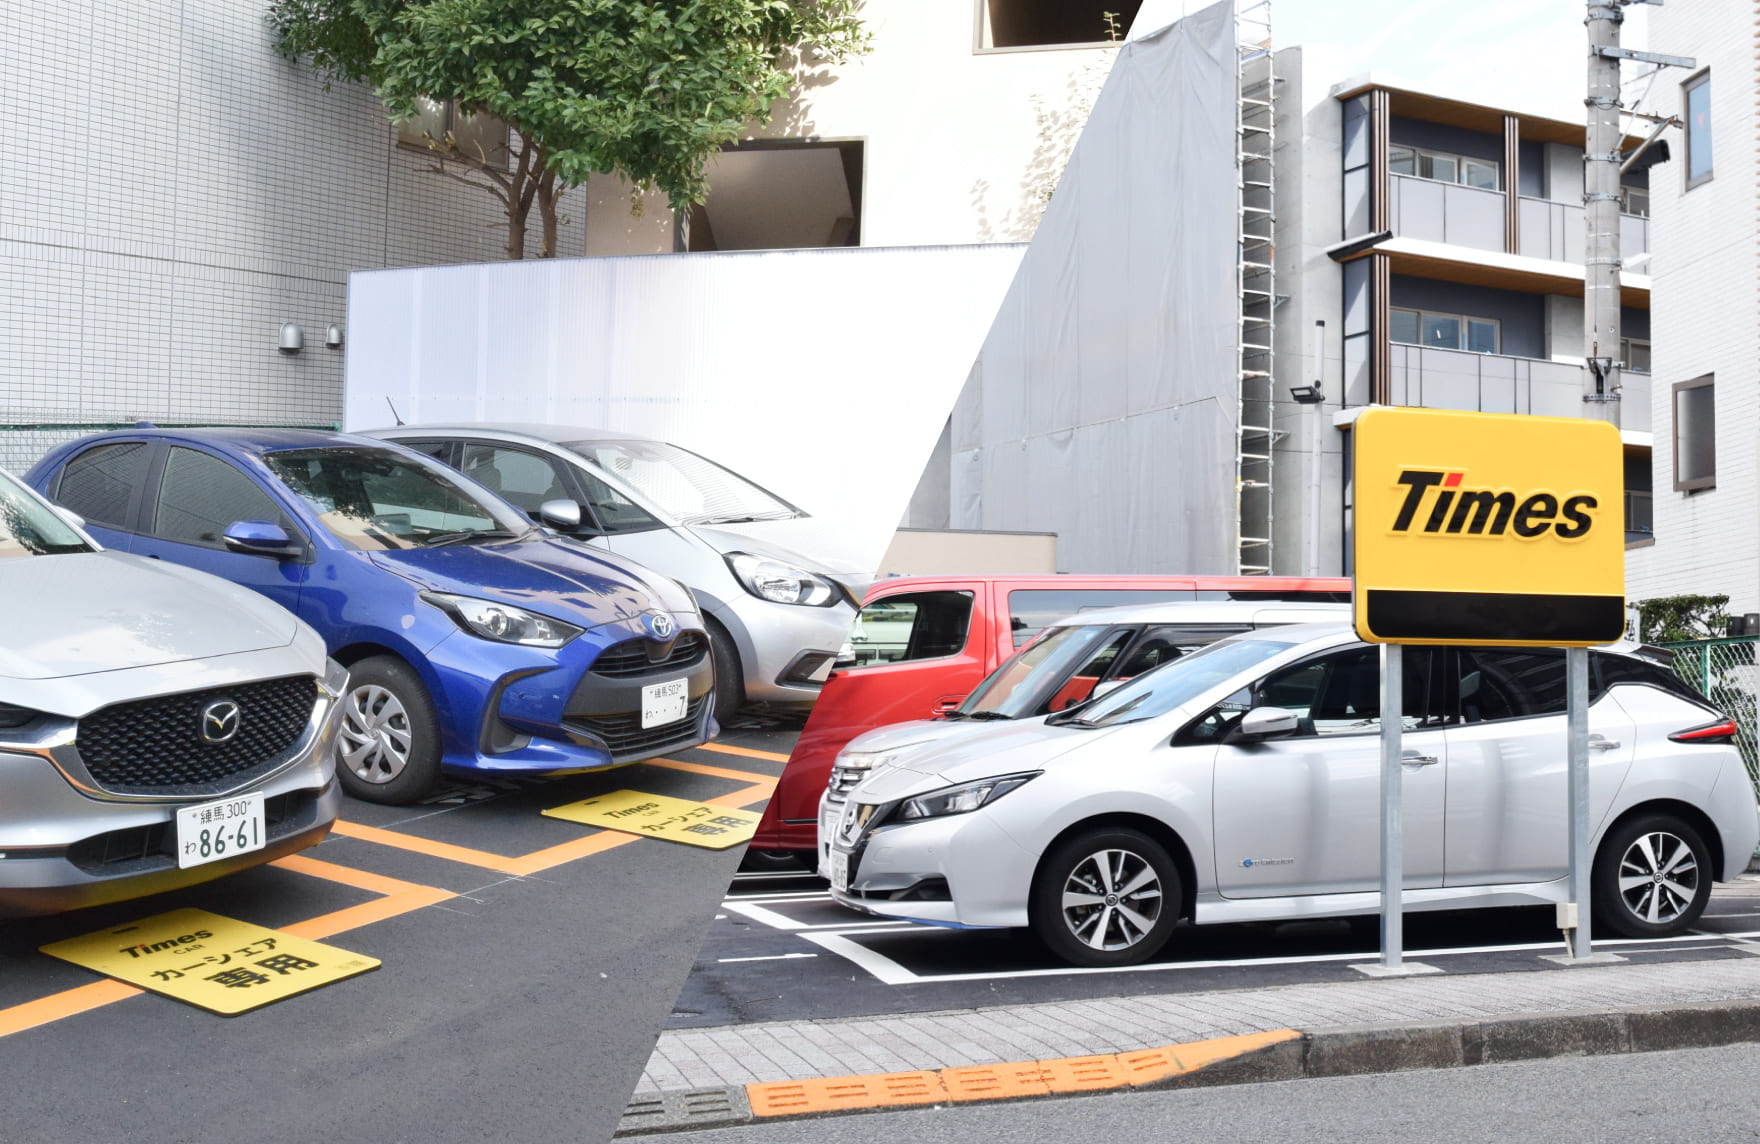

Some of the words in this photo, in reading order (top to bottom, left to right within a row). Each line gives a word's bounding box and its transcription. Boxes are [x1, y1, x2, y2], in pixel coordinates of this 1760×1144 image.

[1391, 470, 1598, 539] Times
[200, 805, 225, 825] 練馬
[226, 800, 247, 819] 300
[601, 802, 660, 819] Times
[640, 806, 713, 832] カーシェア
[184, 841, 197, 856] わ
[199, 816, 258, 858] 86-61
[680, 815, 754, 836] 専用
[119, 929, 214, 958] Times
[173, 944, 206, 955] CAR
[150, 937, 278, 981] カーシェア
[202, 953, 320, 988] 専用
